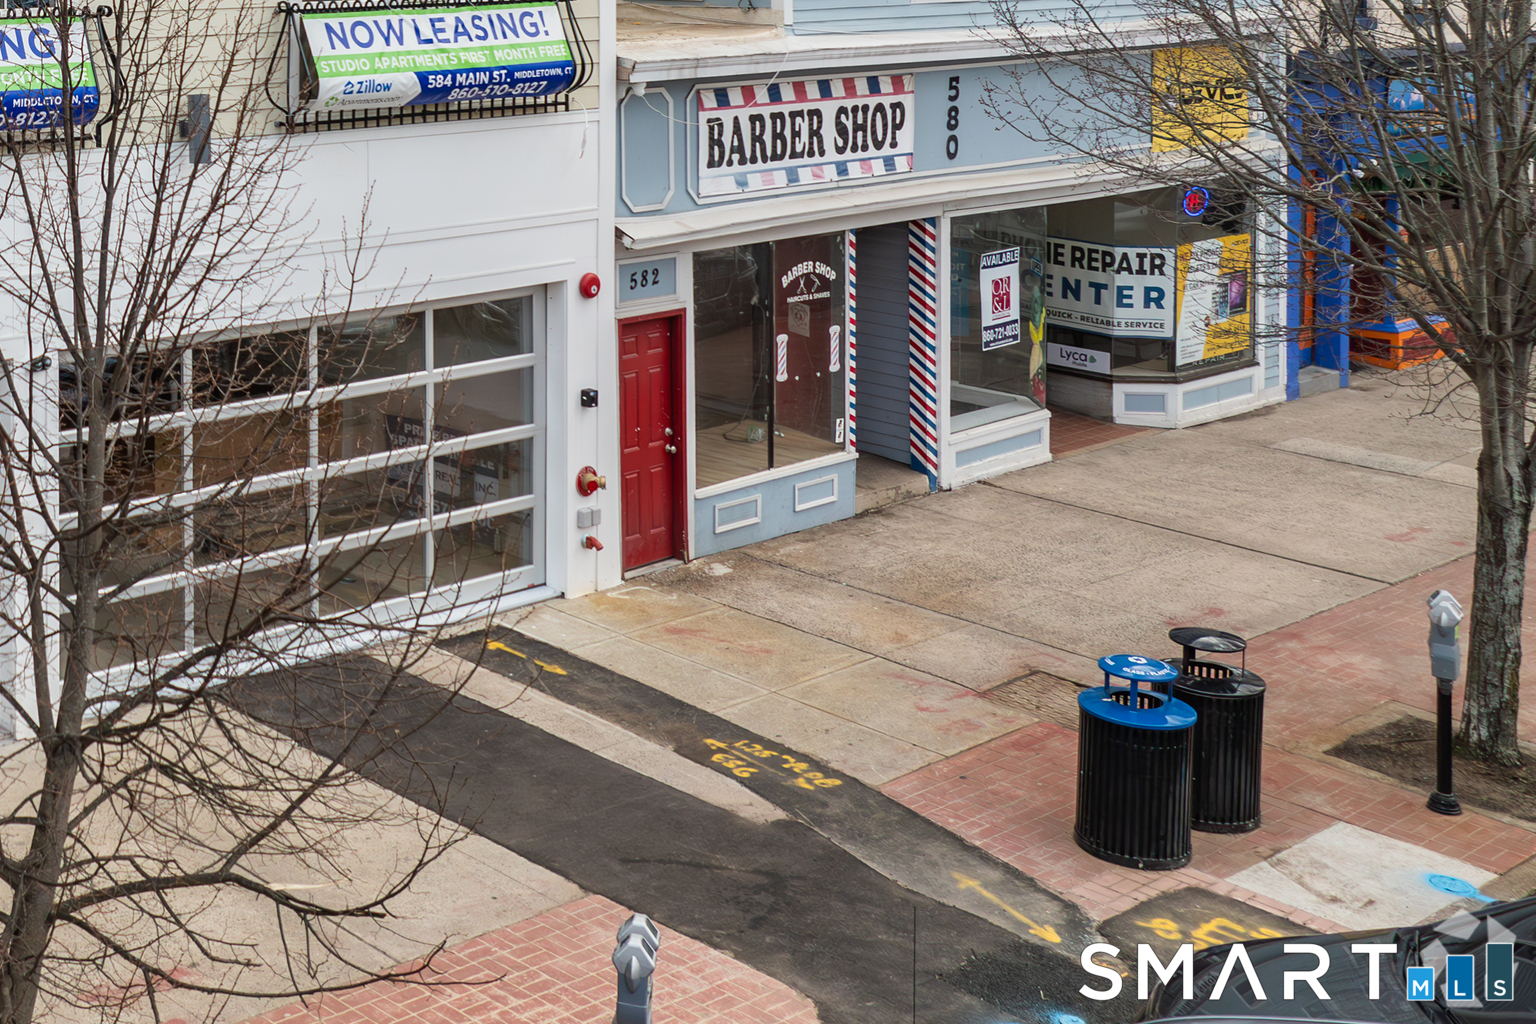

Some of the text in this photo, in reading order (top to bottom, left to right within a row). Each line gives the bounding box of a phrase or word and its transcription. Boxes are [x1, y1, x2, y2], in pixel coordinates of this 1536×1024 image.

[324, 10, 550, 51] NOW LEASING!
[320, 43, 568, 74] STUDIO APARTMENTS FIRST MONTH FREE
[51, 66, 89, 82] FEE
[427, 66, 573, 89] 584 MAIN ST. MIDDLETOWN, CT
[356, 80, 393, 95] Zillow
[447, 81, 548, 101] 860-570-8127
[13, 94, 81, 109] MIDDLETON,
[83, 94, 95, 104] CT
[706, 101, 906, 169] BARBER SHOP
[981, 249, 1019, 267] AVAILABLE
[1070, 245, 1166, 276] REPAIR
[629, 267, 661, 292] 582
[781, 261, 837, 289] BARBER SHOP
[786, 294, 809, 304] HAIRCUTS
[813, 291, 831, 300] SHAVES
[1046, 309, 1073, 320] QUICK
[1080, 315, 1122, 329] RELIABLE
[1124, 322, 1166, 330] SERVICE
[1059, 347, 1088, 362] Lyca
[1122, 666, 1145, 676] GLASS
